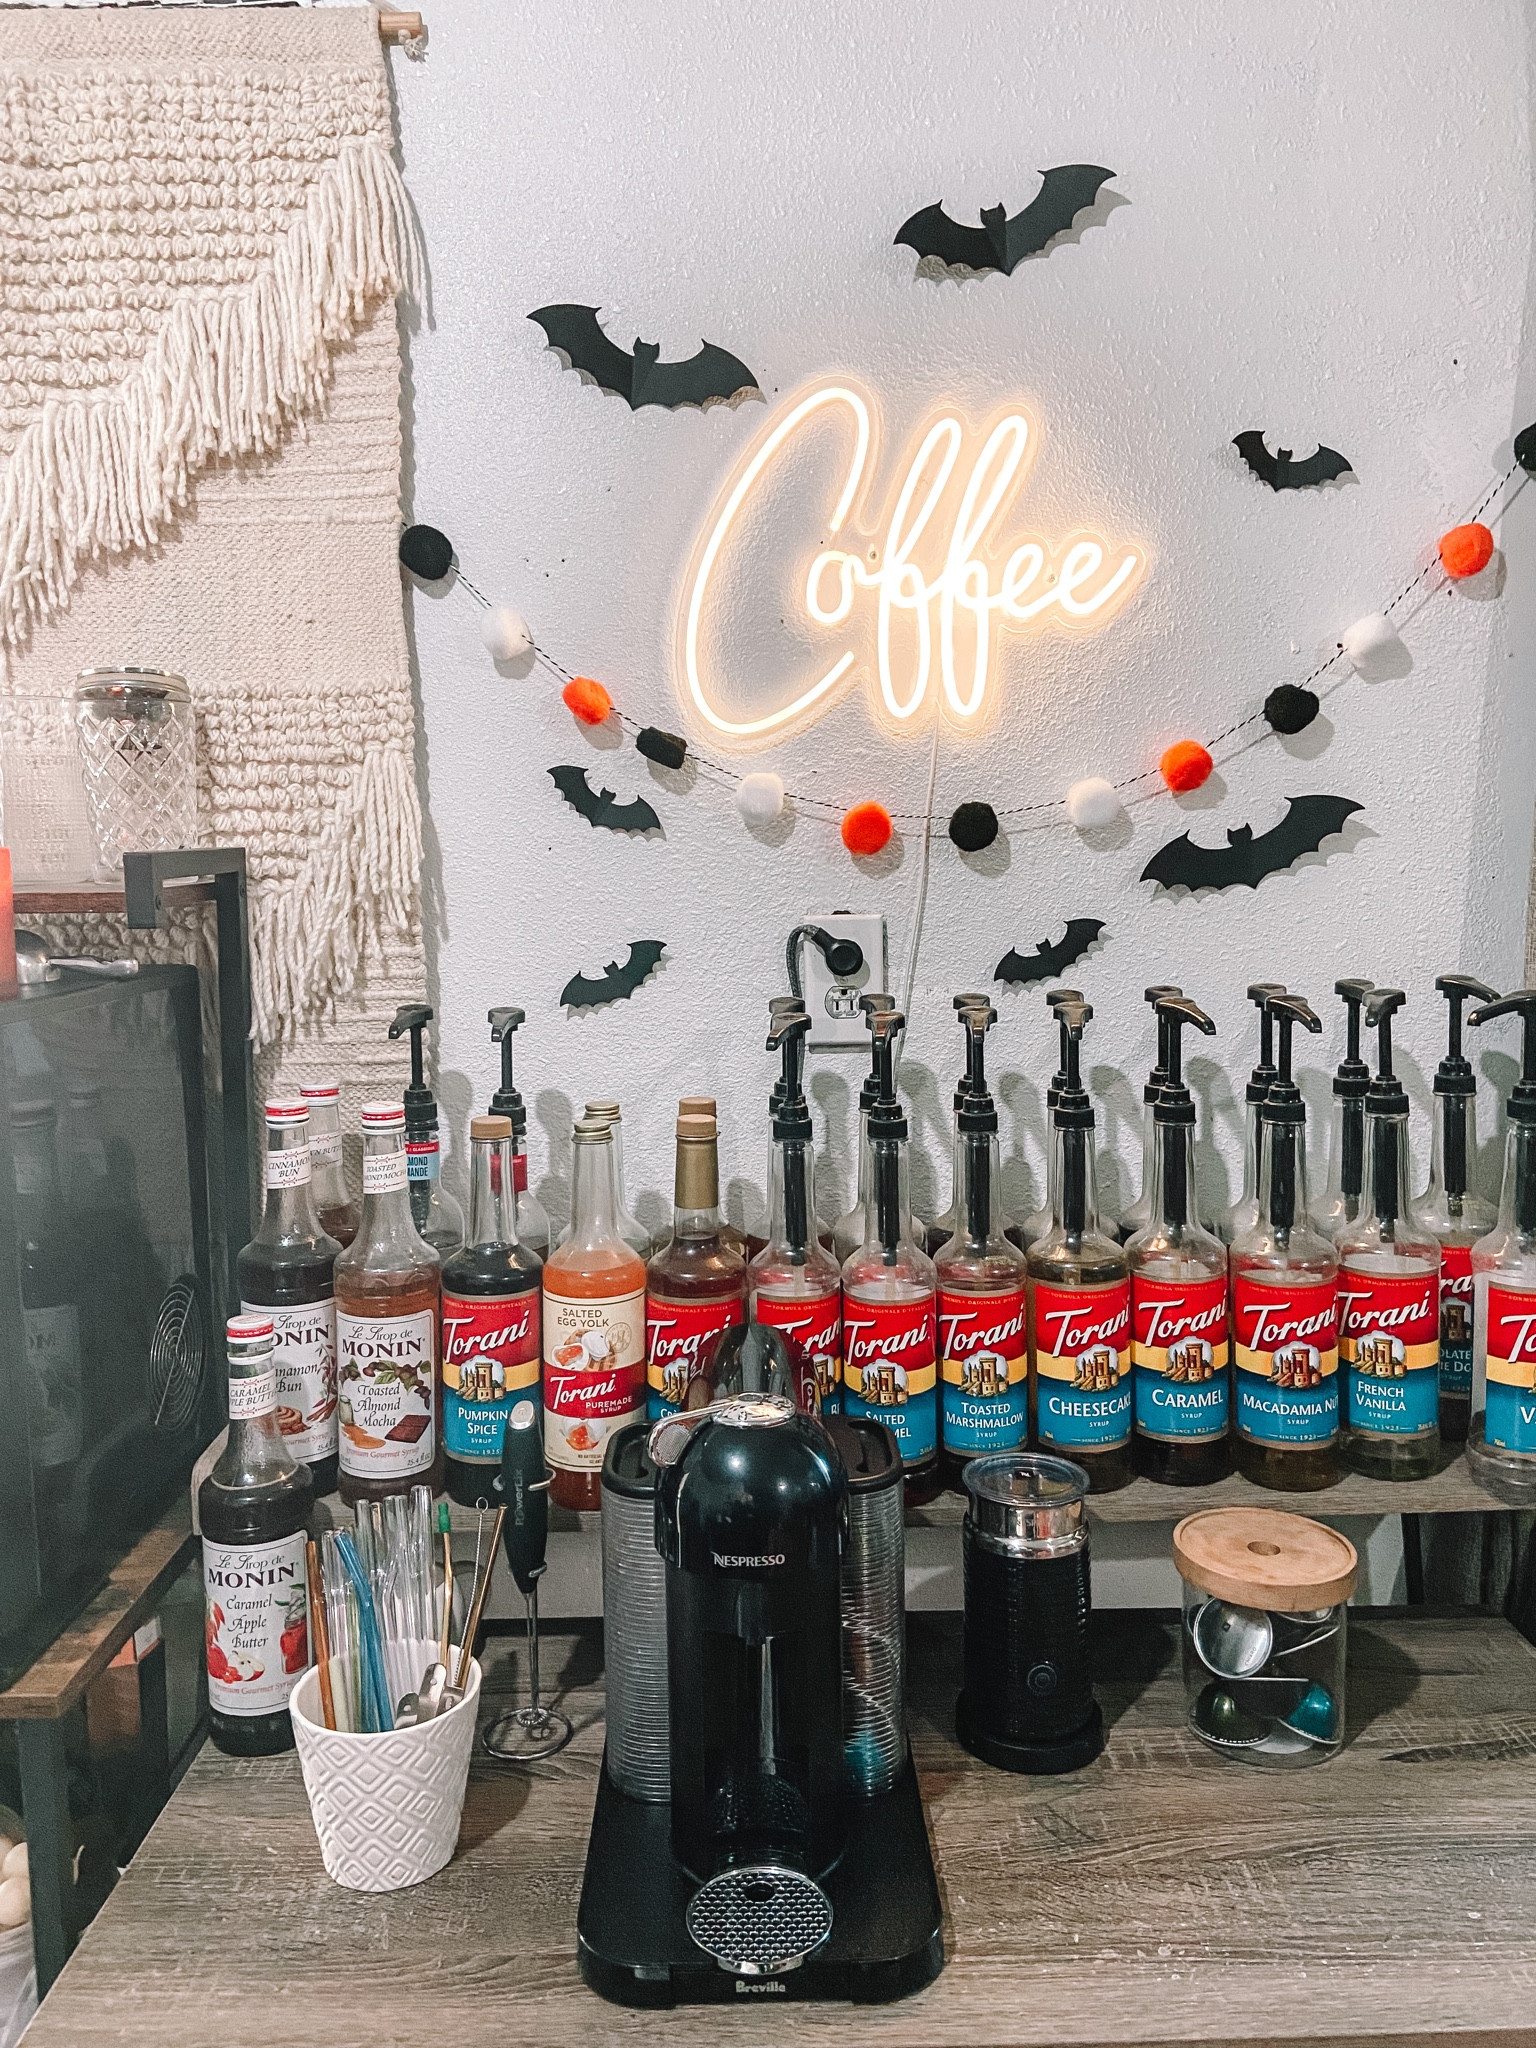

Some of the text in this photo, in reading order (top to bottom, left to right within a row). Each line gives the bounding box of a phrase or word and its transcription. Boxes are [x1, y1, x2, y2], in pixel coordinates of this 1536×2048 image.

[686, 387, 1137, 735] Coffee
[563, 1308, 602, 1318] SALTED
[1139, 1290, 1226, 1347] Torani
[1337, 1290, 1431, 1336] Torani
[274, 1315, 307, 1330] Sirop
[309, 1317, 321, 1325] de
[557, 1317, 609, 1327] EGG YOLK
[1243, 1295, 1336, 1351] Torani
[272, 1324, 330, 1346] ONIN
[349, 1326, 412, 1346] Le Sirop de
[443, 1309, 530, 1363] Torani
[844, 1314, 928, 1365] Torani
[939, 1303, 1024, 1360] Torani
[342, 1338, 422, 1358] MONIN
[276, 1377, 301, 1392] Bun
[357, 1382, 401, 1396] Toasted
[550, 1374, 617, 1410] Torani
[1358, 1381, 1404, 1397] FRENCH
[353, 1397, 401, 1412] Almond
[585, 1395, 633, 1409] PUREMADE
[1152, 1389, 1223, 1408] CARAMEL
[1243, 1393, 1323, 1415] MACADAMIA
[1356, 1393, 1406, 1411] VANILLA
[458, 1407, 508, 1421] PUMPKIN
[600, 1406, 622, 1414] SYRUP
[961, 1402, 1010, 1415] TOASTED
[1368, 1411, 1391, 1419] SYRUP
[359, 1411, 397, 1427] Mocha
[946, 1411, 1023, 1429] MARSHMALLOW
[467, 1423, 498, 1435] SPICE
[215, 1555, 285, 1571] Le Sirop de
[711, 1551, 786, 1568] NESPRESSO
[208, 1562, 295, 1588] MONIN
[226, 1594, 272, 1610] Caramel
[227, 1615, 267, 1633] Apple
[232, 1634, 268, 1649] Butter
[735, 1980, 786, 1992] Breville
